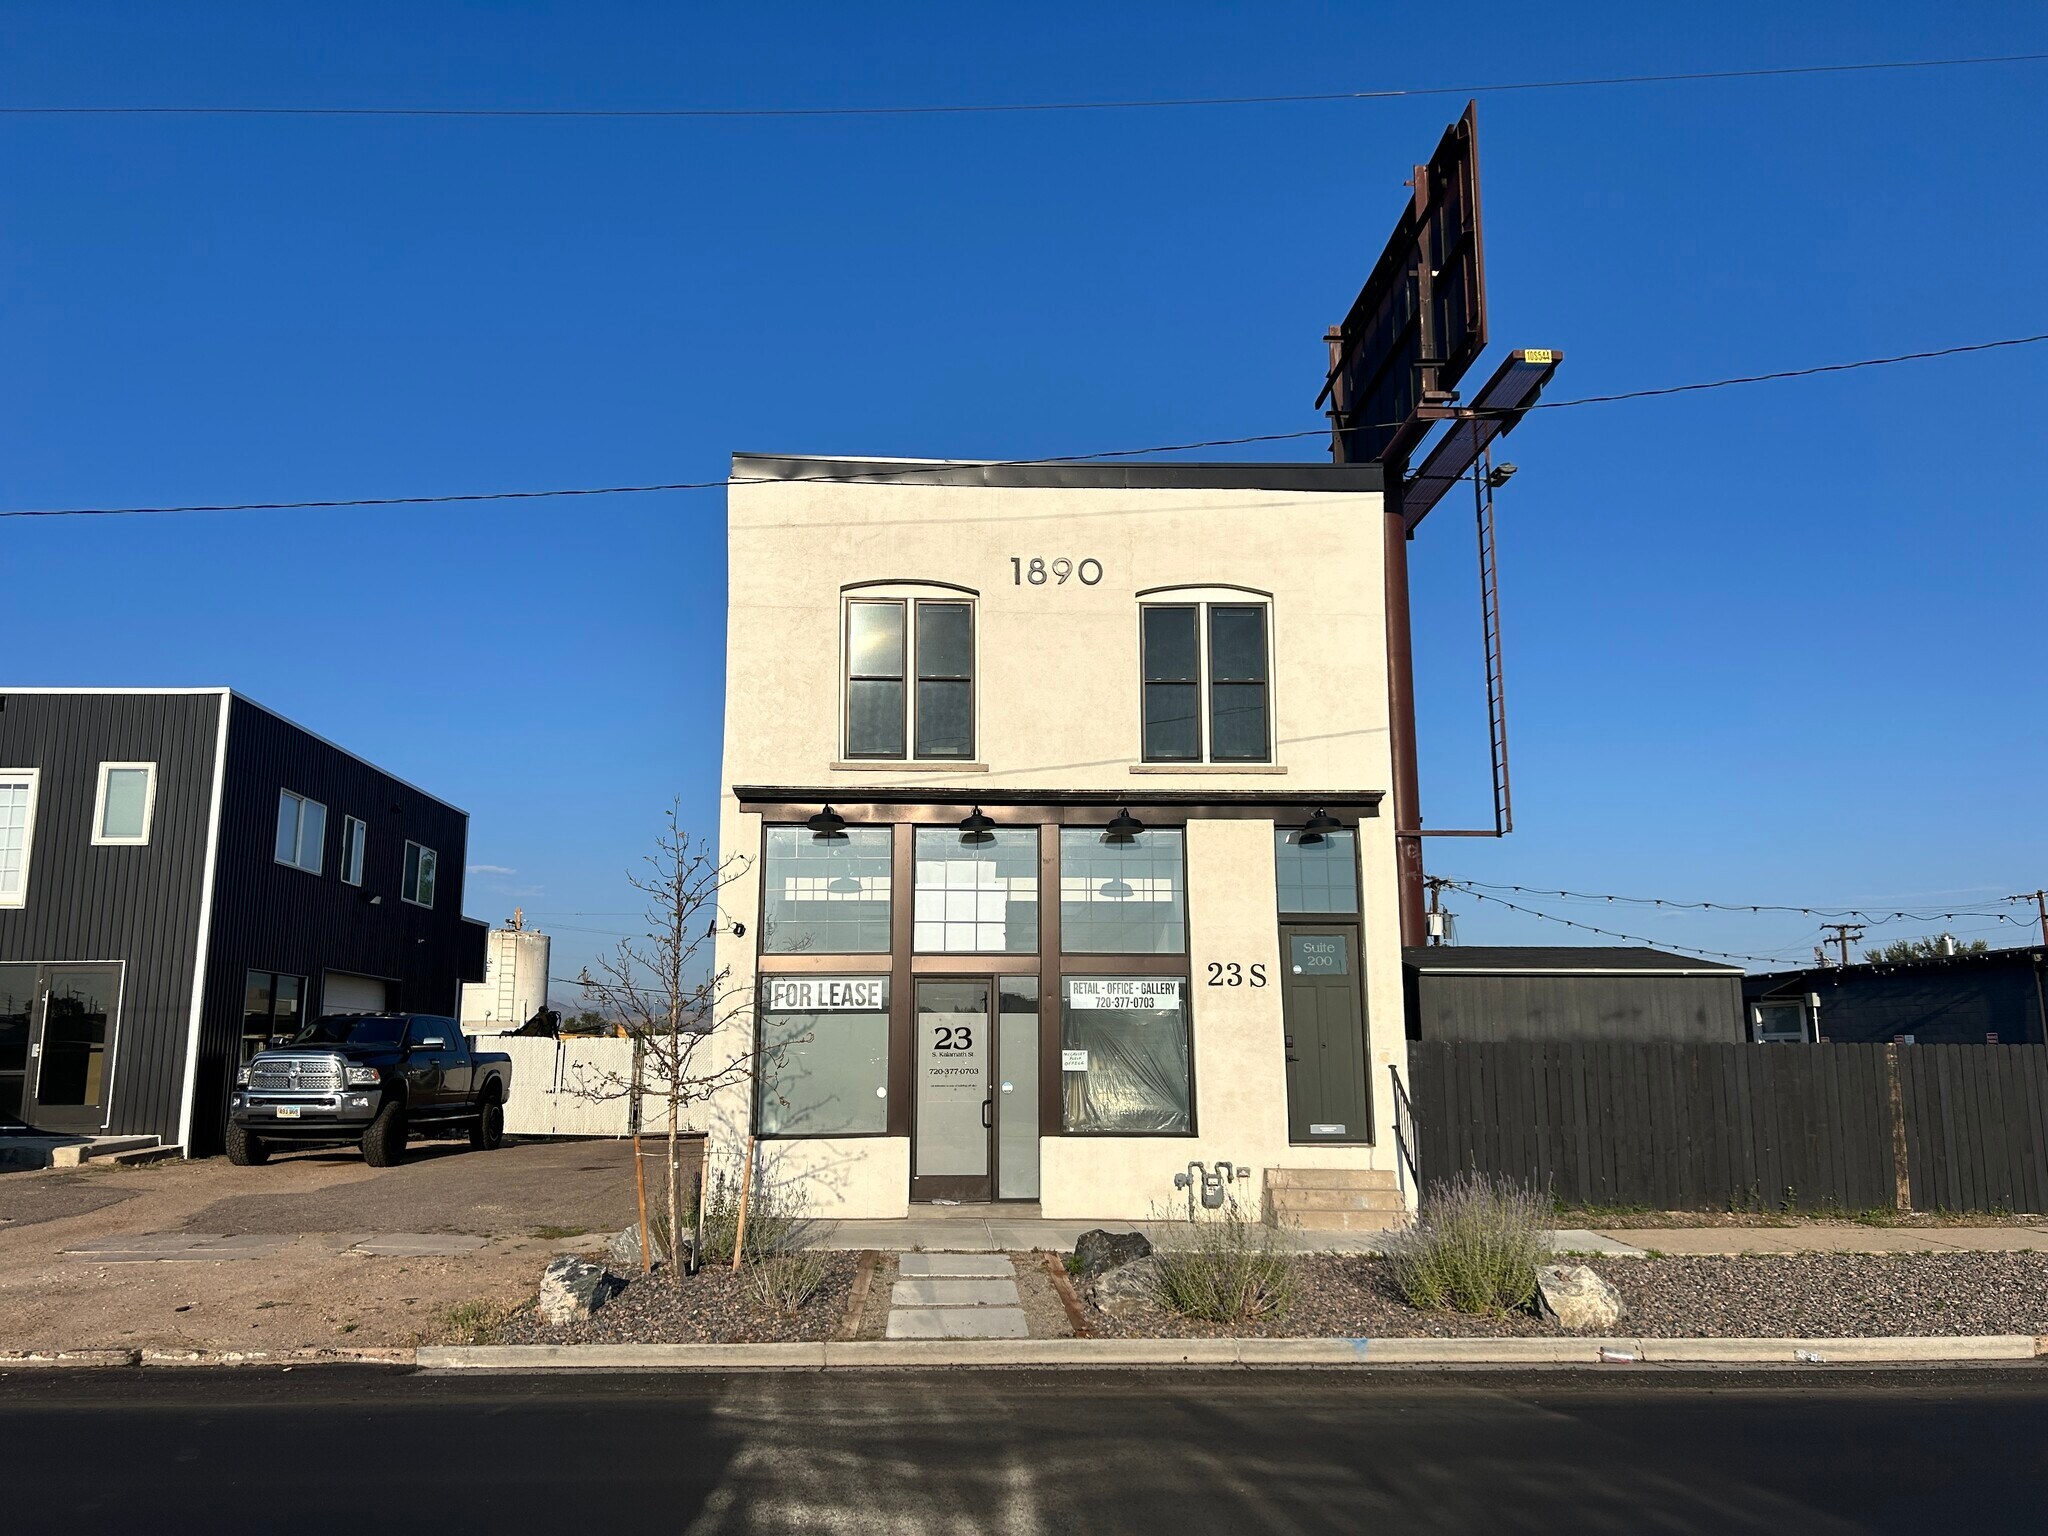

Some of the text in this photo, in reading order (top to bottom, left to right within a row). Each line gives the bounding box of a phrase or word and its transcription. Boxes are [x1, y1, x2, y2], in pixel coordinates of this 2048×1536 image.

[1010, 557, 1103, 585] 1890
[1303, 942, 1335, 953] Suite
[1307, 956, 1333, 966] 200
[1208, 962, 1242, 986] 23
[774, 983, 879, 1007] FOR LEASE
[1073, 982, 1100, 995] RETAIL
[1107, 982, 1134, 995] OFFICE
[1141, 982, 1176, 995] GALLERY
[1095, 997, 1155, 1008] 720-377-0703
[934, 1027, 973, 1050] 23
